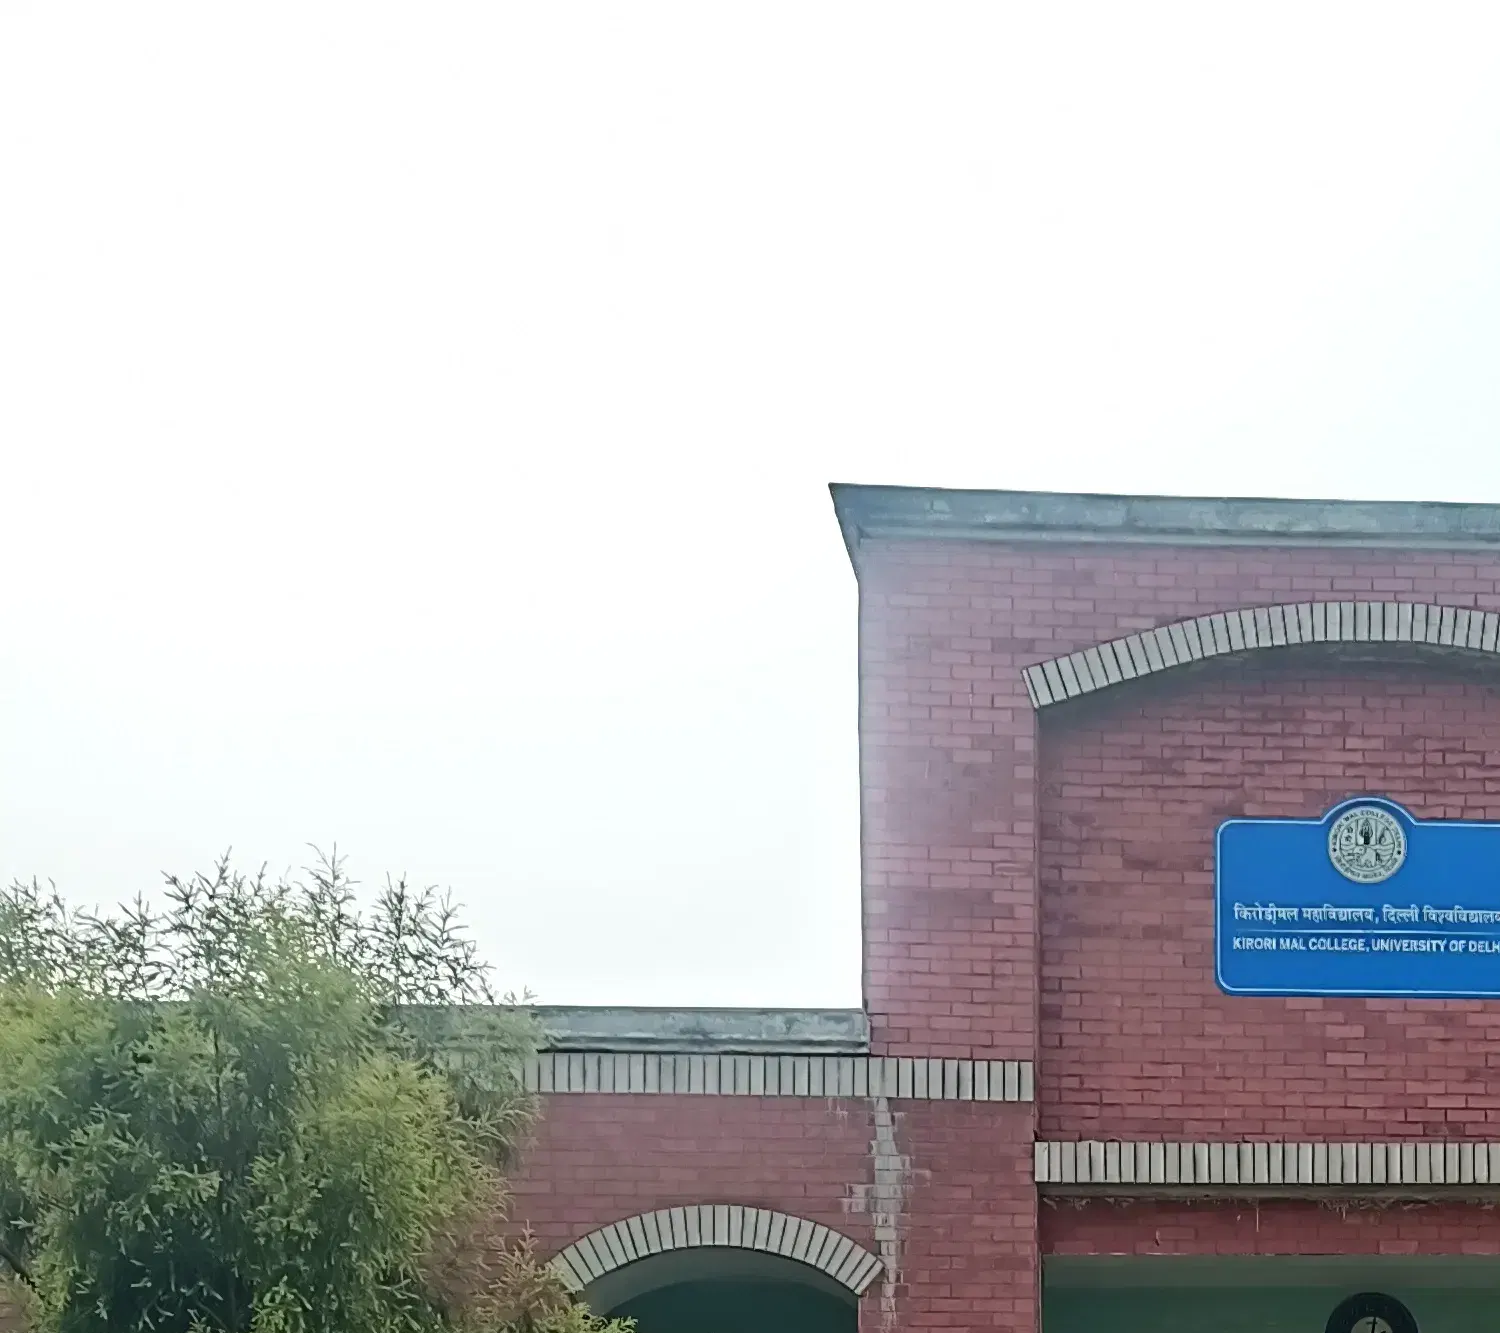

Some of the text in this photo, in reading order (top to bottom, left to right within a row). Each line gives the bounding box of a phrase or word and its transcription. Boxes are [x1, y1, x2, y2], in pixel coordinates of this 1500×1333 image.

[1233, 936, 1276, 951] KIRORI
[1279, 936, 1307, 951] MAL
[1308, 937, 1370, 952] COLLEGE,
[1371, 937, 1447, 952] UNIVERSITY
[1449, 939, 1467, 952] OF
